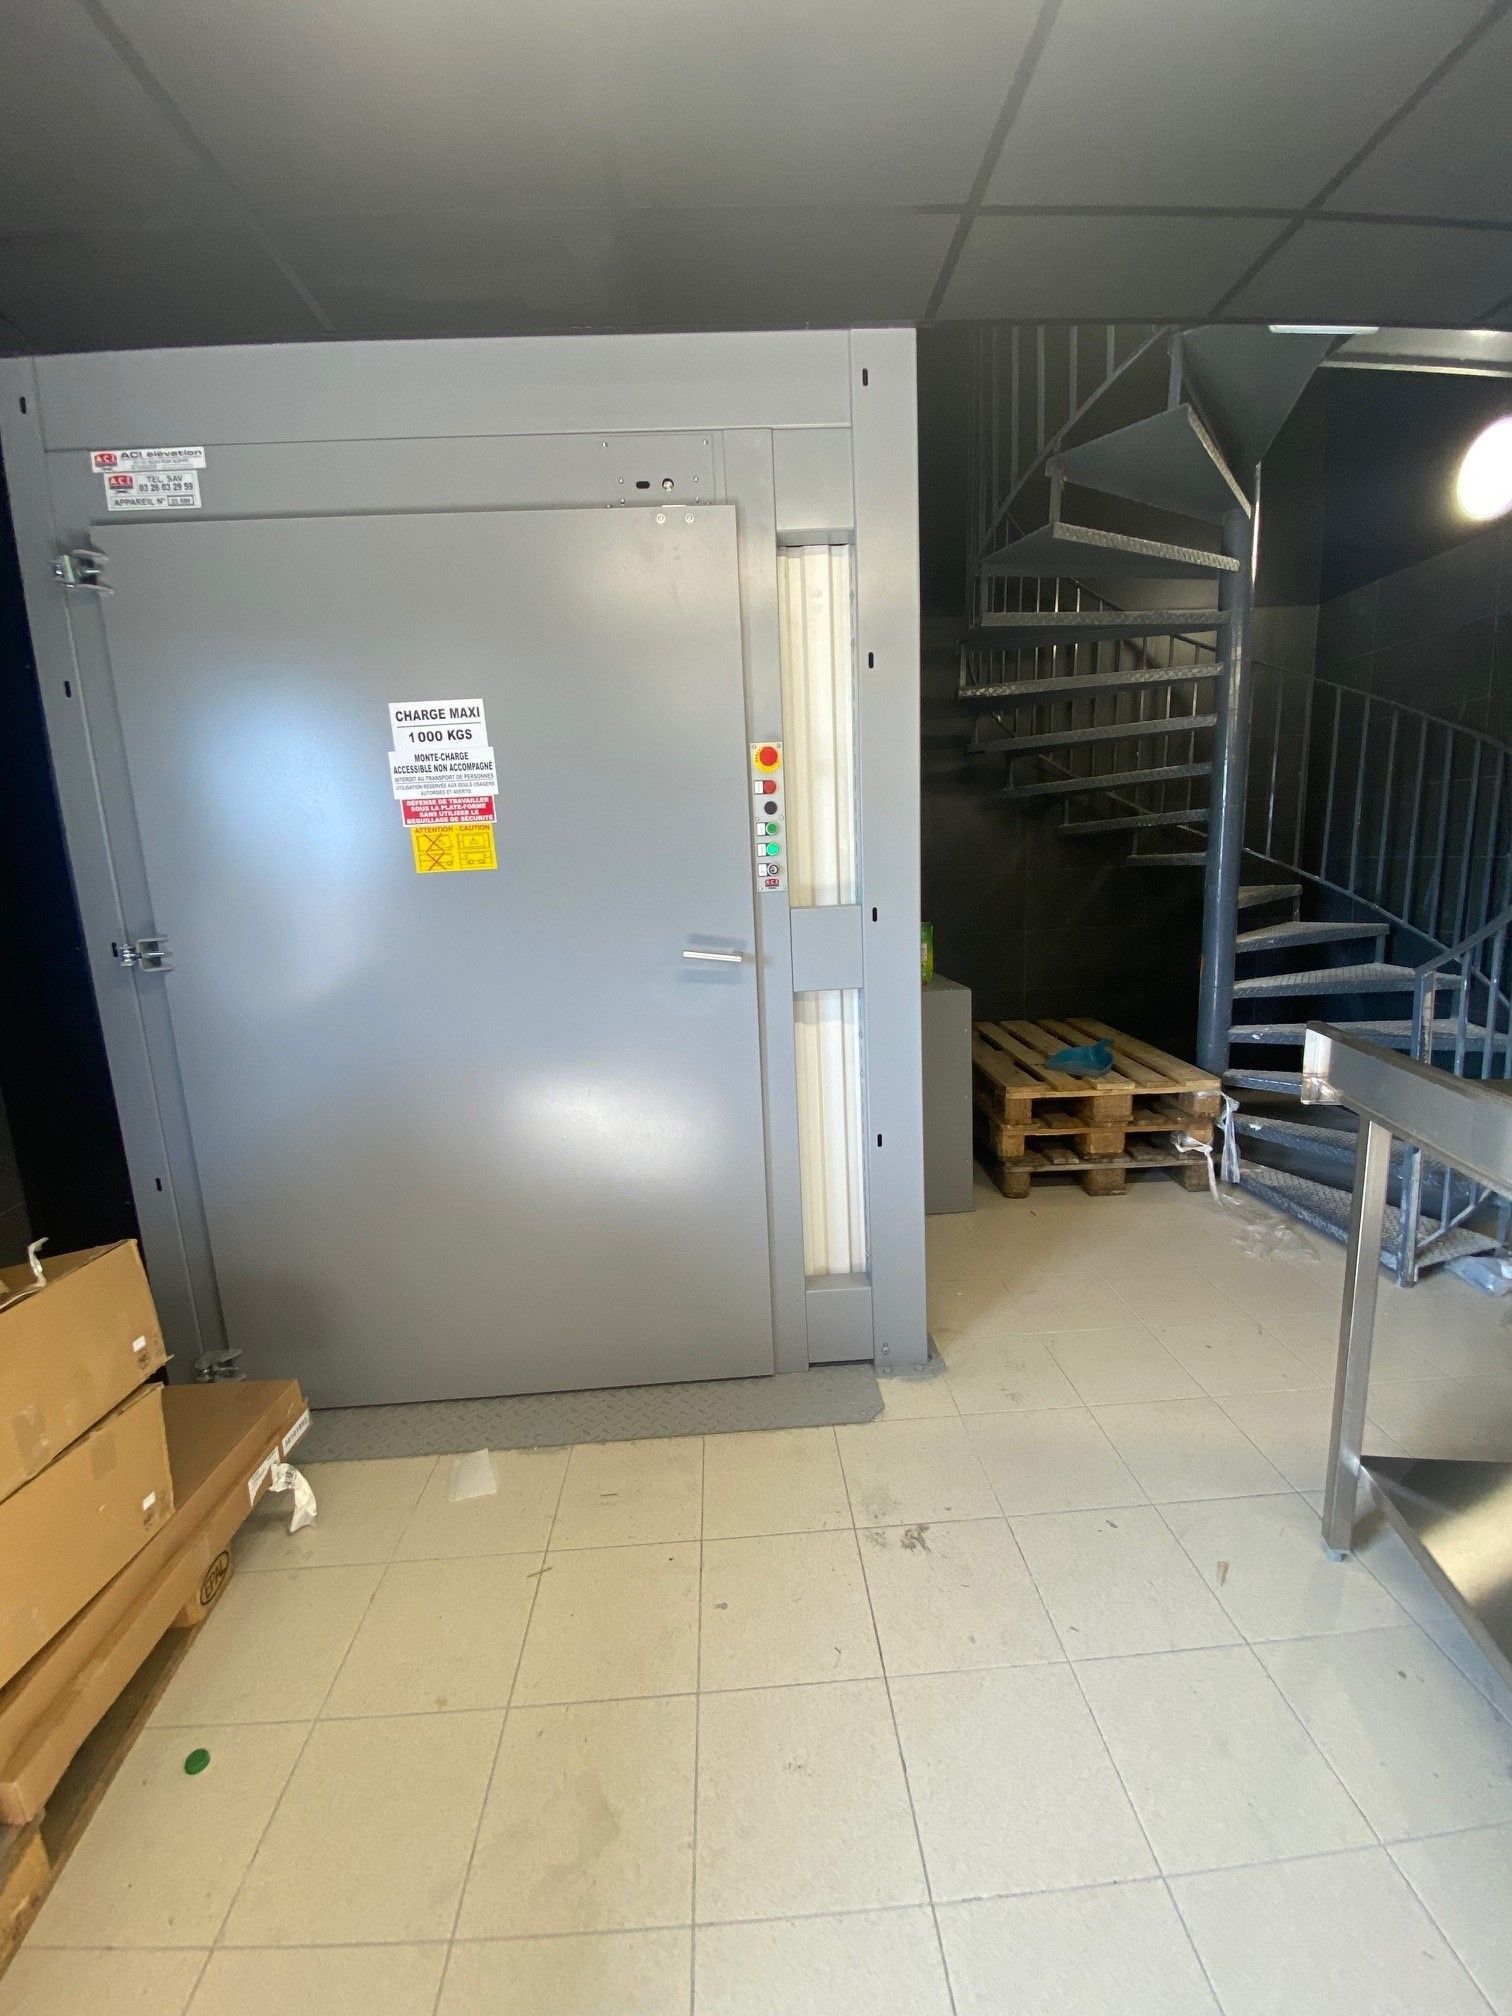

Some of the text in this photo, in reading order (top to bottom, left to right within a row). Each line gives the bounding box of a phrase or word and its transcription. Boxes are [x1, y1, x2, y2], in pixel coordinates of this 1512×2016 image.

[96, 455, 116, 463] ACI
[121, 451, 142, 460] ACI
[110, 477, 131, 485] ACI
[139, 484, 148, 492] 03
[162, 483, 171, 491] 03
[184, 482, 193, 490] 59
[114, 498, 154, 507] APPAREIL
[395, 706, 480, 722] CHARGE MAXI
[447, 729, 472, 740] KGS
[414, 752, 469, 762] MONTE-CHARGE
[393, 760, 493, 774] ACCESSIBLE NON ACCOMPAGNÉ
[414, 826, 454, 834] ATTENTION
